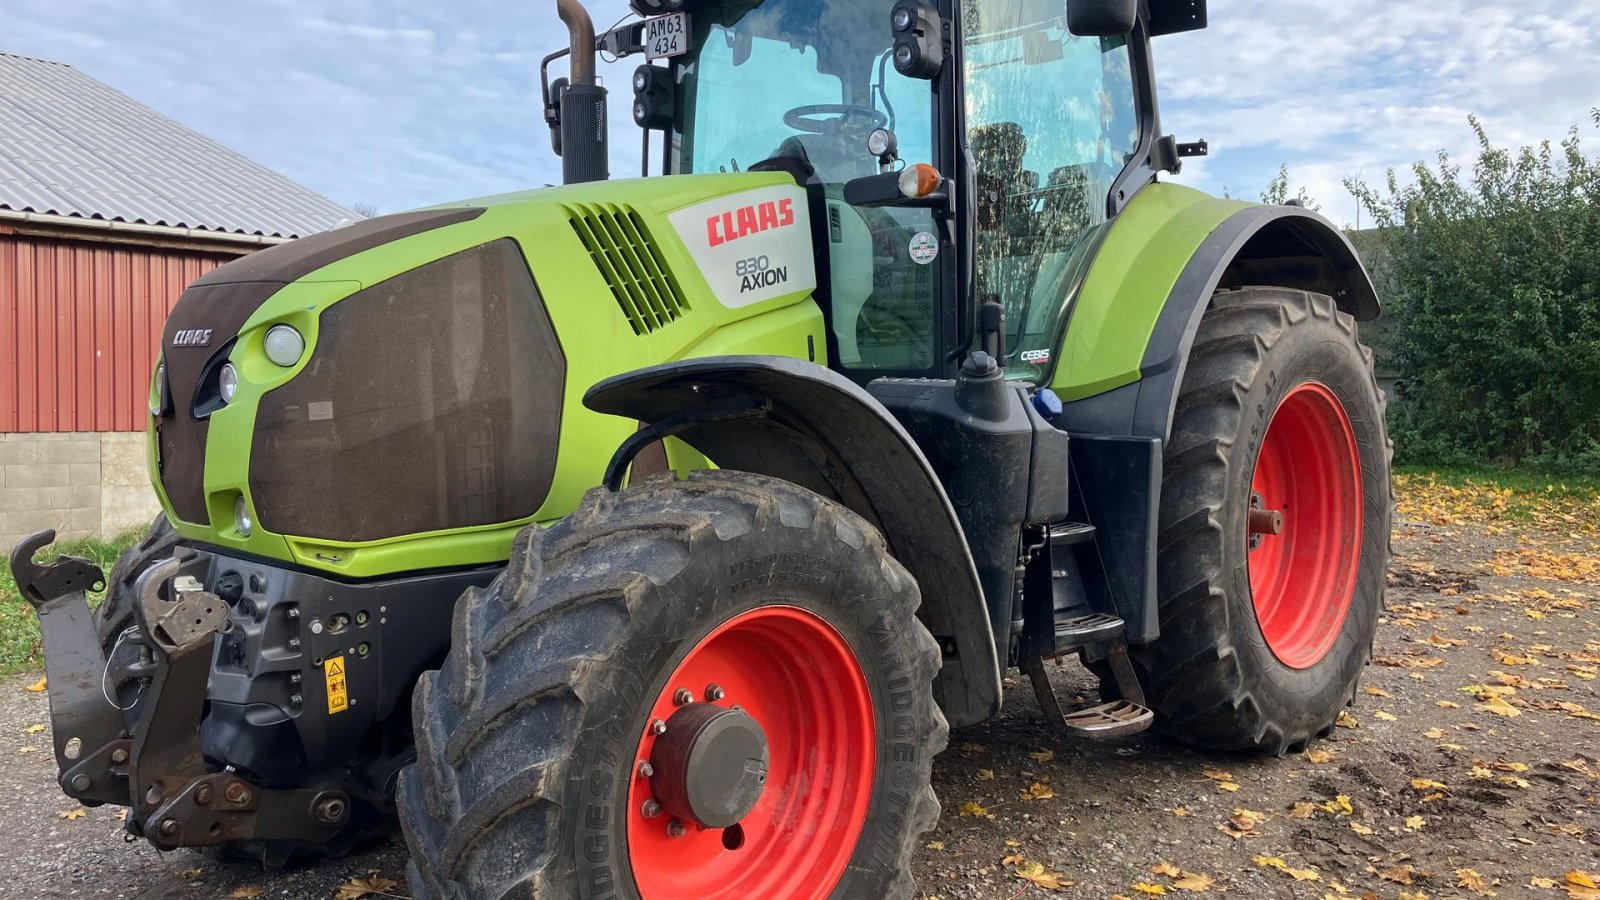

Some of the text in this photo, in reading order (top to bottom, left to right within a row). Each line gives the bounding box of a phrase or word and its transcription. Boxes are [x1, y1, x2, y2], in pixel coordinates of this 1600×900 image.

[649, 15, 681, 40] AM63
[655, 35, 677, 54] 434
[706, 198, 794, 248] CLAAS
[736, 255, 769, 277] 830
[740, 266, 788, 293] AXION
[173, 329, 212, 346] CLAAS
[1021, 349, 1050, 361] CEBIS
[1265, 370, 1277, 396] 42
[864, 627, 915, 876] BRIDGESTON
